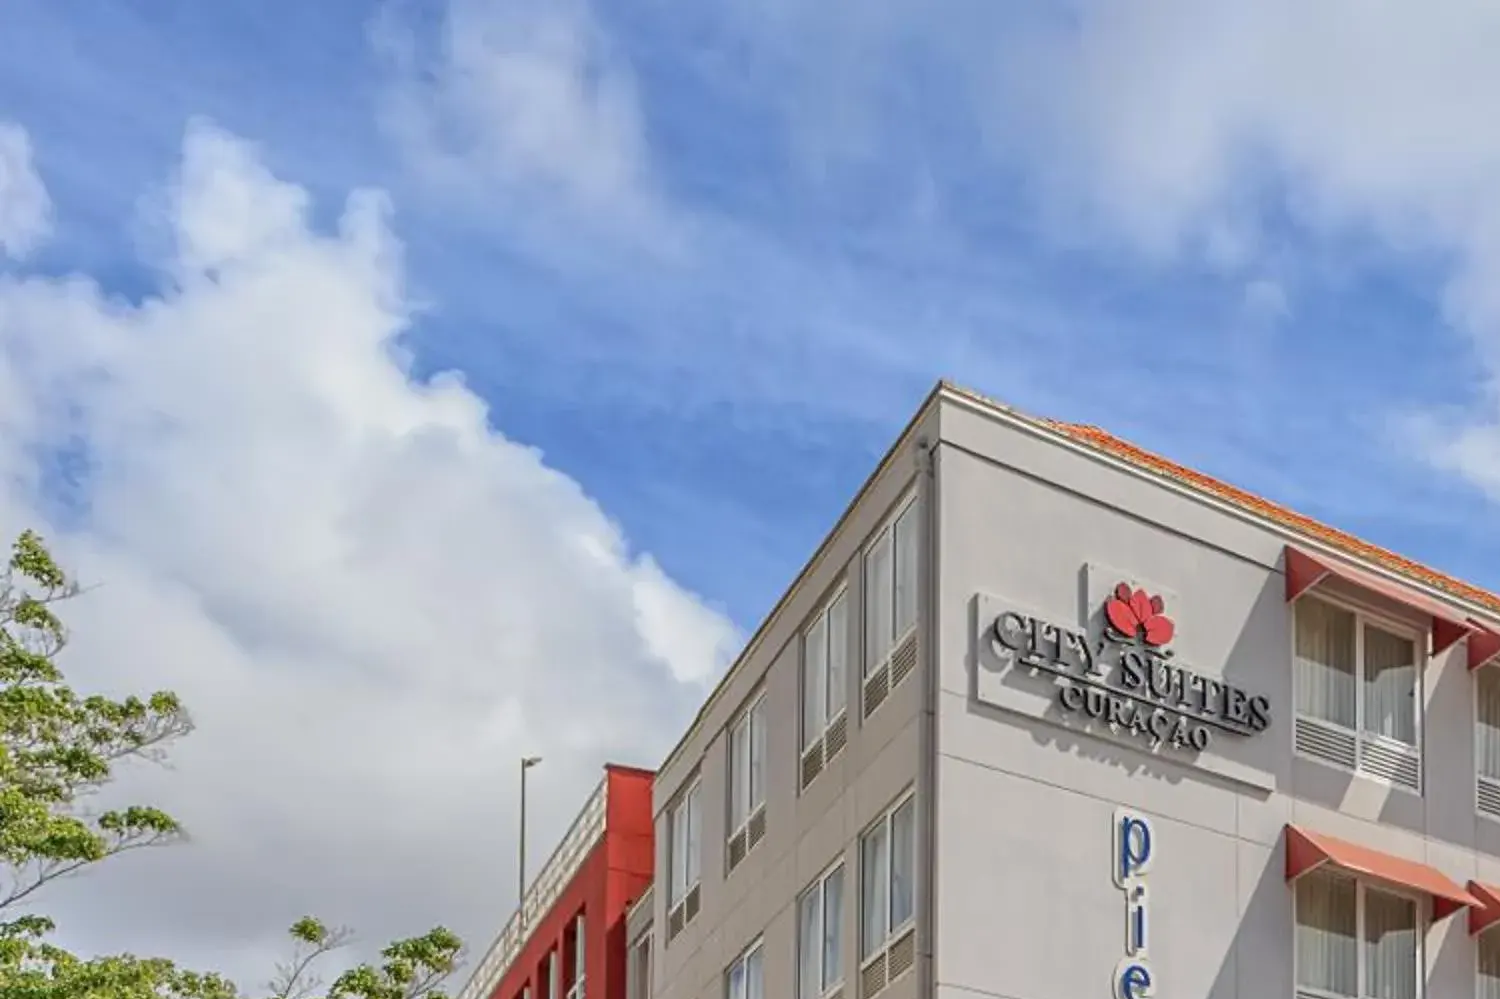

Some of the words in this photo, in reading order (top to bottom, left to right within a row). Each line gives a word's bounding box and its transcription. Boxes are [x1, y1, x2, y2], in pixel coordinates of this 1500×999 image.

[993, 610, 1108, 677] CITY
[1120, 649, 1270, 733] SUITES
[1059, 685, 1211, 753] CURAÇAO
